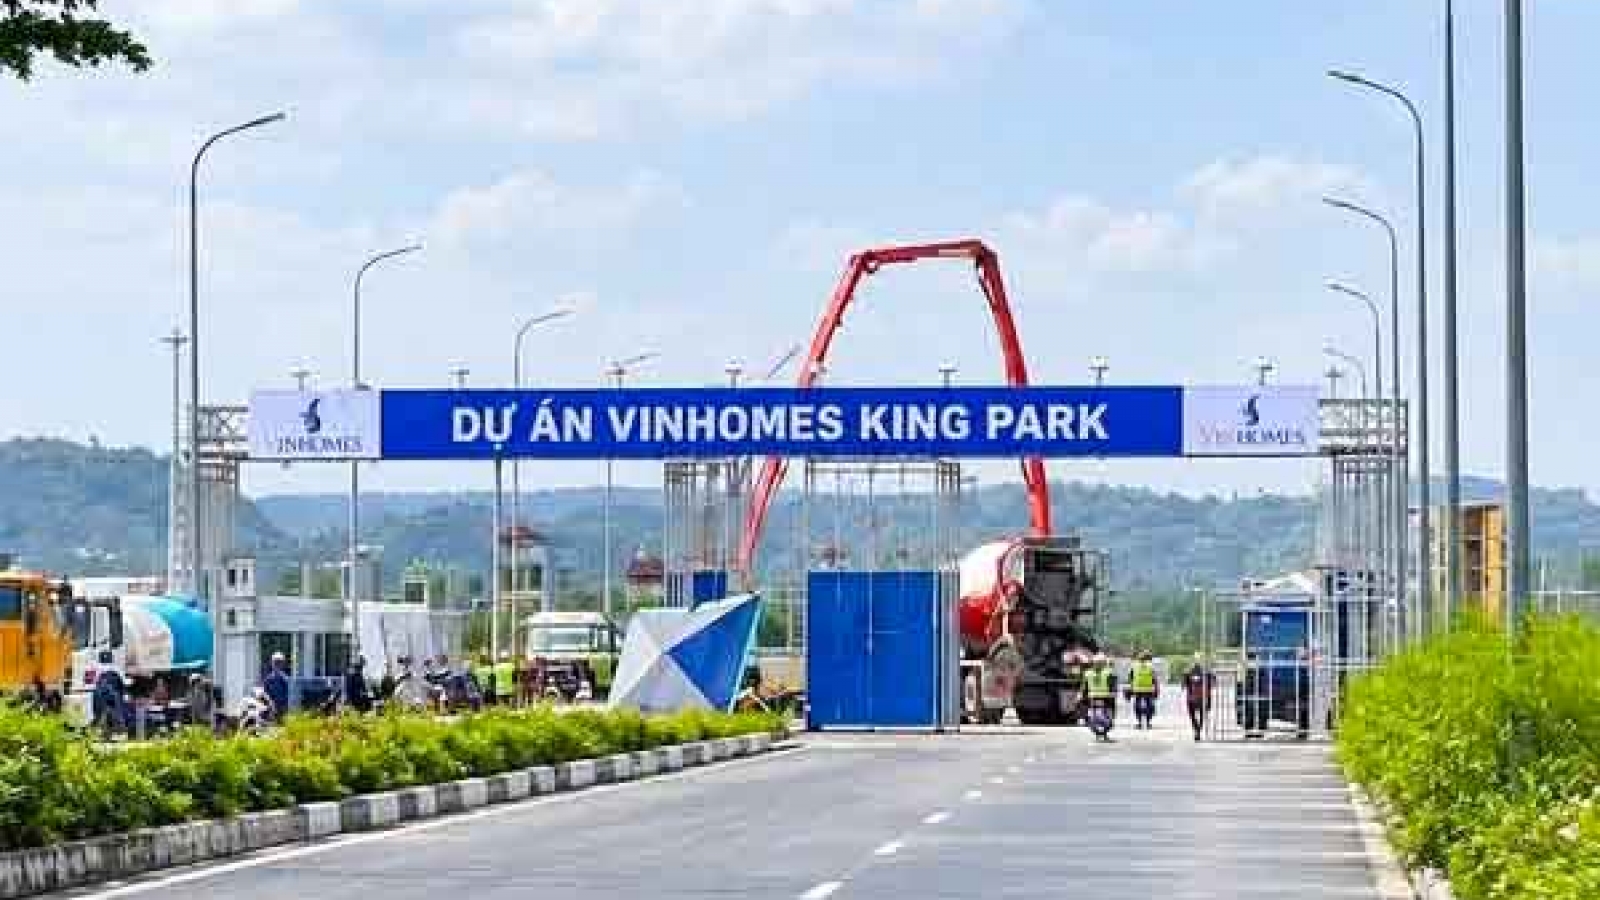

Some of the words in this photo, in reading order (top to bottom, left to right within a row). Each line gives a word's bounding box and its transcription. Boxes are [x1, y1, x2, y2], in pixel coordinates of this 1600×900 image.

[452, 401, 518, 450] DỰ
[530, 398, 593, 442] ÁN
[607, 405, 844, 442] VINHOMES
[860, 405, 969, 441] KING
[986, 403, 1108, 440] PARK
